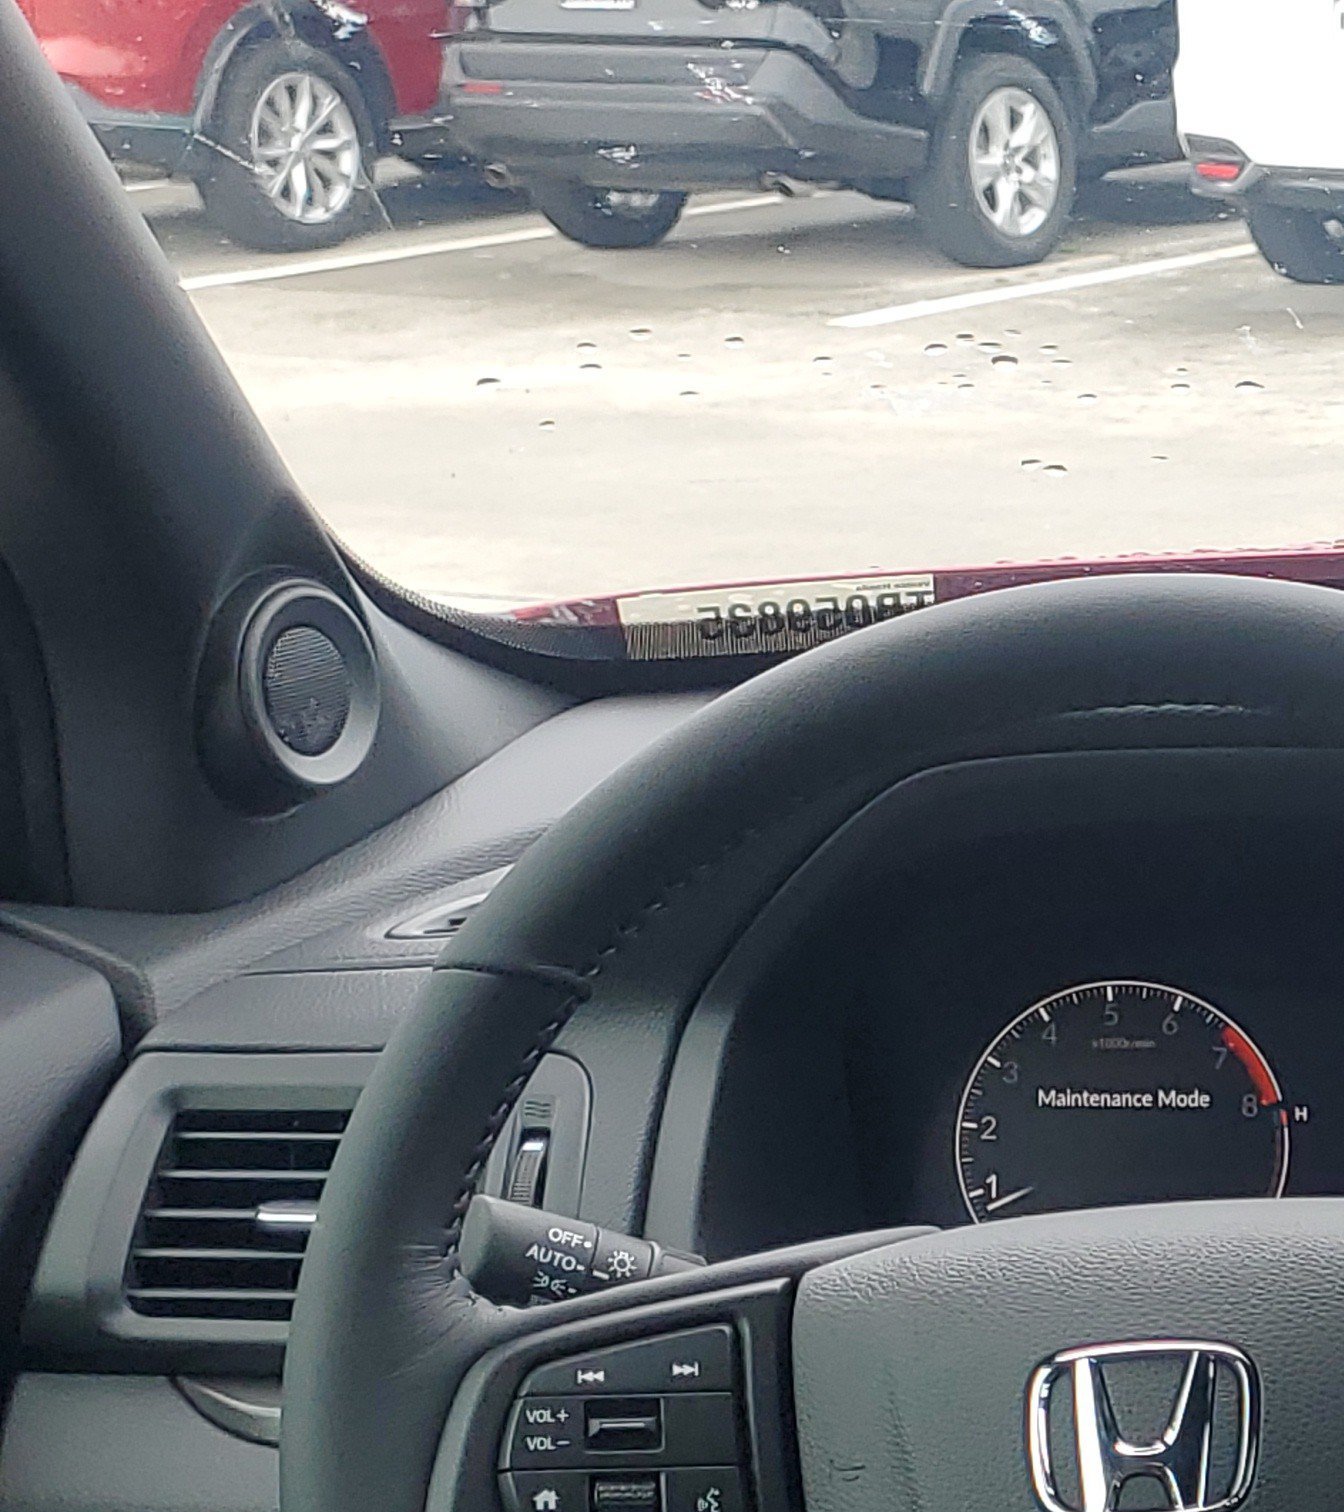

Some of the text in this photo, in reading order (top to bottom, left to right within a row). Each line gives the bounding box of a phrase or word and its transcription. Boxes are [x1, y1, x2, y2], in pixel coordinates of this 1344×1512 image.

[1103, 1003, 1119, 1026] 5
[1161, 1013, 1178, 1035] 6
[1041, 1022, 1057, 1044] 4
[1212, 1047, 1227, 1069] 7
[1002, 1061, 1019, 1083] 3
[1037, 1089, 1211, 1107] Maintenance Mode
[1241, 1093, 1258, 1117] 8
[1294, 1106, 1308, 1122] H
[979, 1115, 998, 1140] 2
[985, 1174, 998, 1199] 1
[548, 1227, 585, 1248] OFF
[526, 1245, 576, 1270] AUTO
